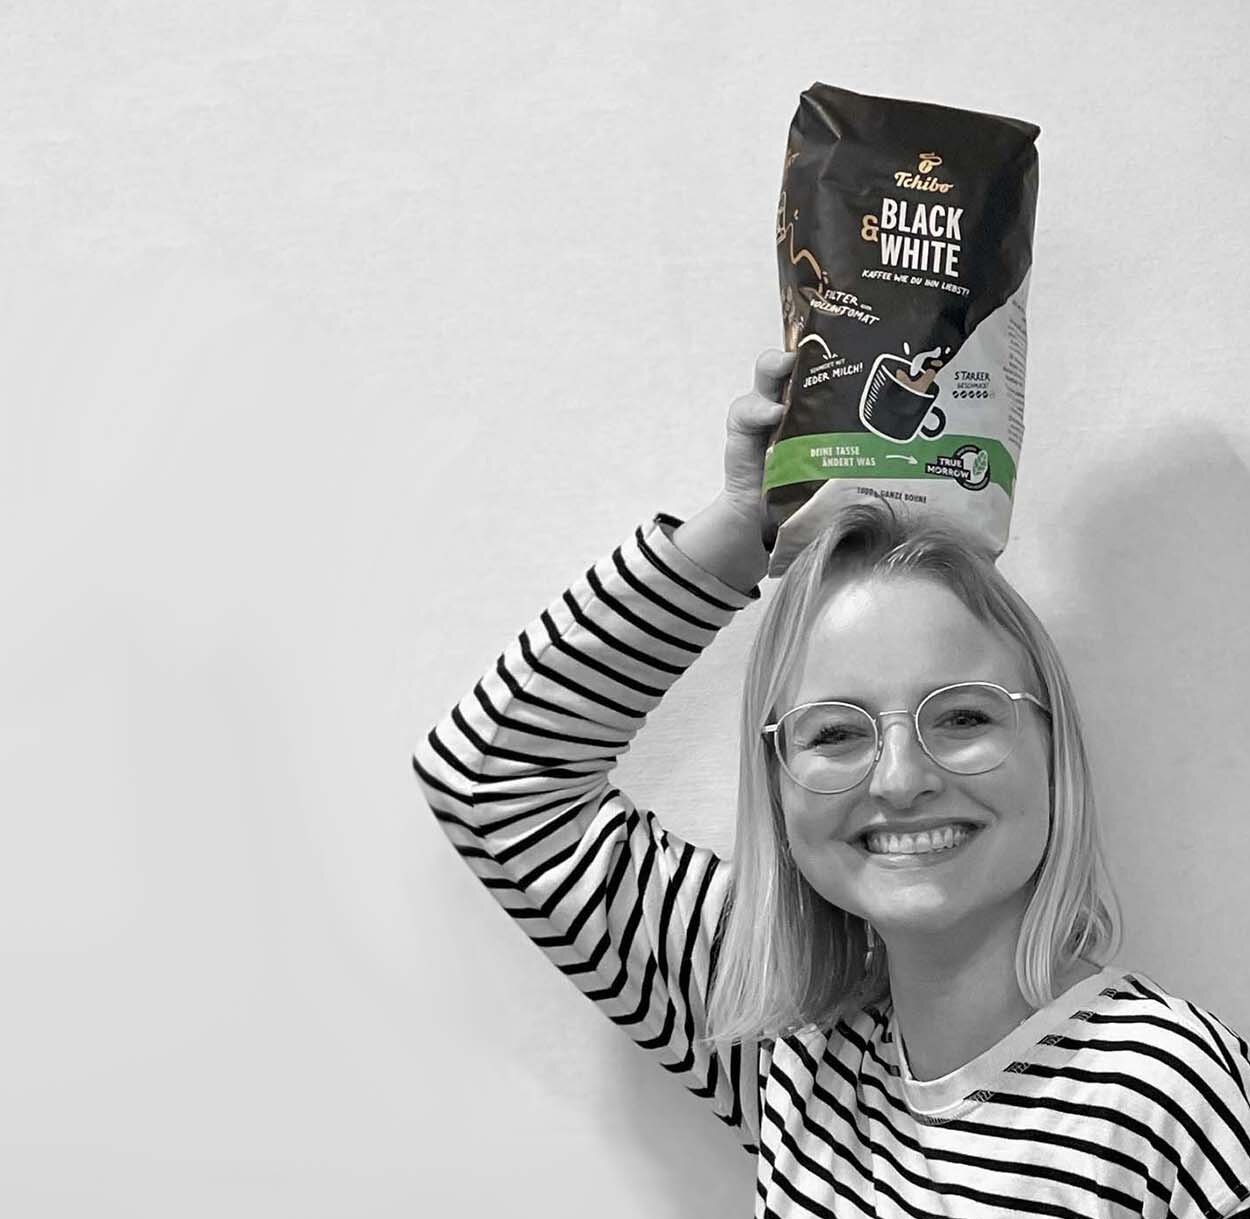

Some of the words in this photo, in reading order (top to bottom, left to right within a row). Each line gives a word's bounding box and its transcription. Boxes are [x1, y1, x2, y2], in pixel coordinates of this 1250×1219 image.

[894, 171, 954, 193] Tchibo
[880, 197, 964, 240] BLACK
[861, 214, 880, 242] &
[880, 232, 961, 277] WHITE
[862, 269, 892, 280] KAFFEE
[893, 272, 909, 284] WIE
[910, 275, 922, 285] DU
[824, 289, 858, 306] FILTER
[803, 372, 830, 388] JEDER
[832, 362, 863, 378] MILCH!
[810, 447, 832, 457] DEINE
[836, 446, 860, 455] TASSE
[855, 457, 876, 466] WAS
[940, 458, 962, 468] TRUE
[927, 465, 969, 478] MORROW
